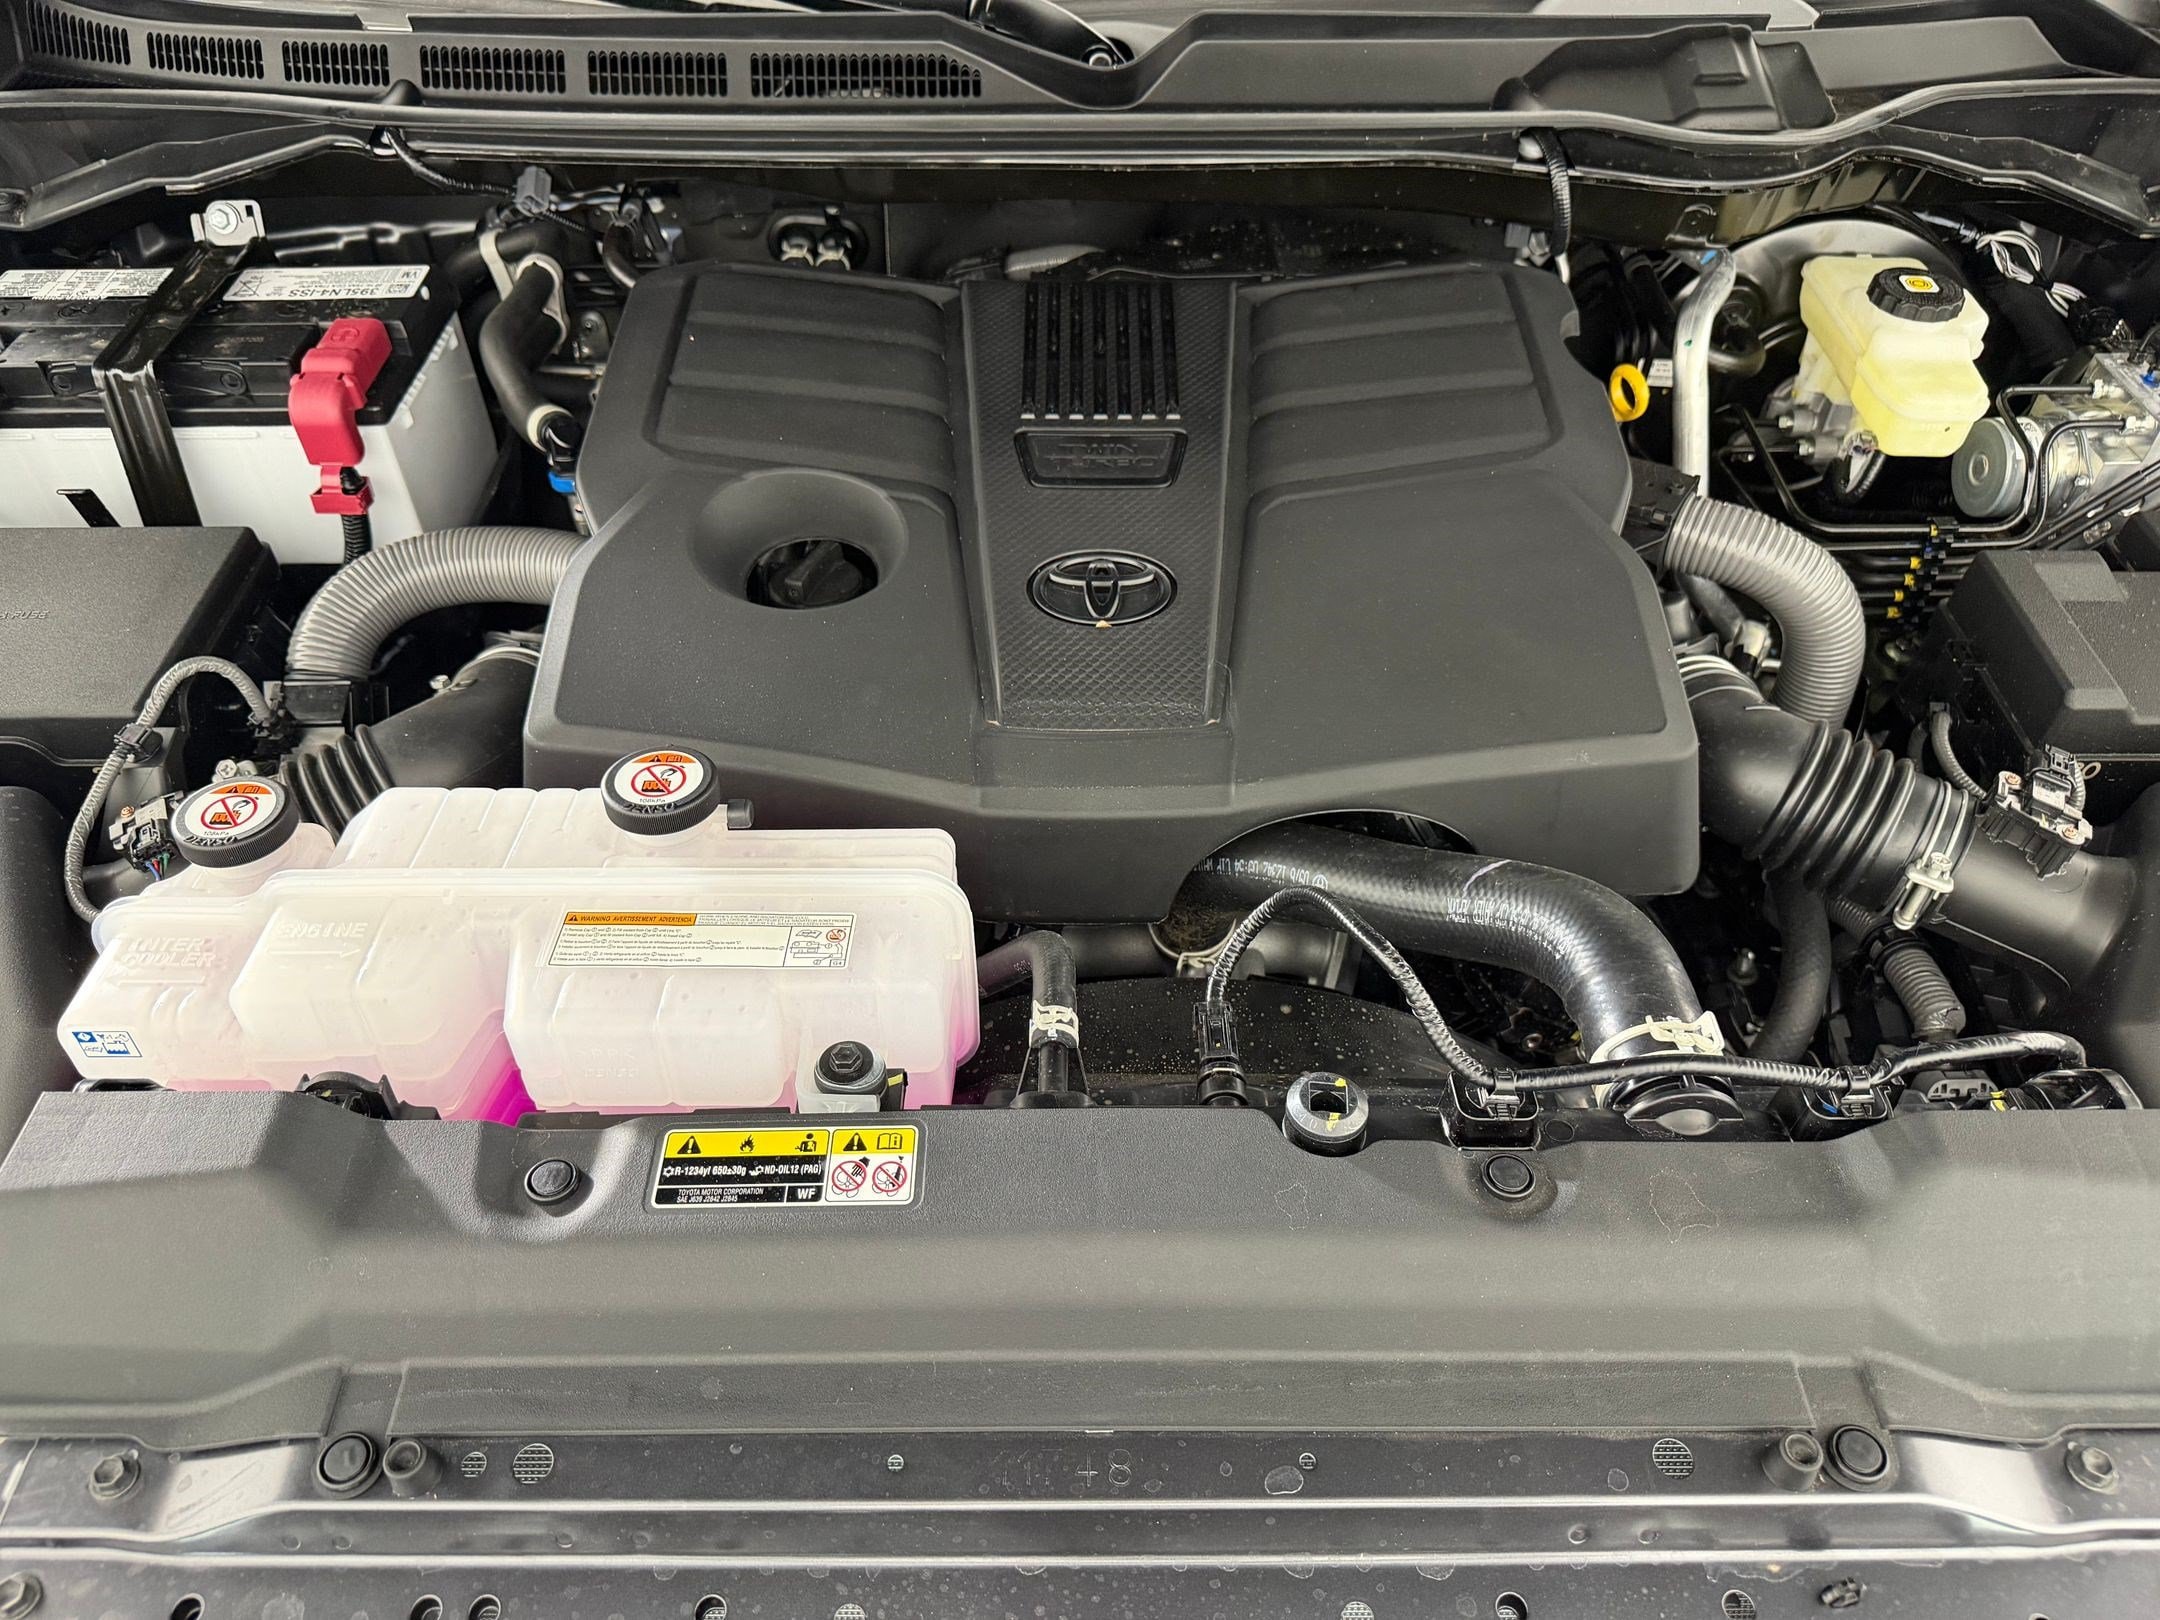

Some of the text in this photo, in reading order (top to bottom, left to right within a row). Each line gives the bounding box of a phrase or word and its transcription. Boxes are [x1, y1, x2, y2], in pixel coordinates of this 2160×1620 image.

[287, 287, 380, 298] 395LN4-ISS
[12, 609, 50, 620] FUSE
[184, 835, 236, 847] DENSO
[580, 915, 611, 923] WARNING
[277, 922, 369, 939] ENGINE
[129, 936, 208, 951] INTER
[120, 952, 216, 968] COOLER
[711, 1165, 747, 1177] 650±30g
[800, 1163, 822, 1176] (PAG)
[723, 1187, 764, 1195] CORPORATION
[797, 1188, 816, 1200] WF
